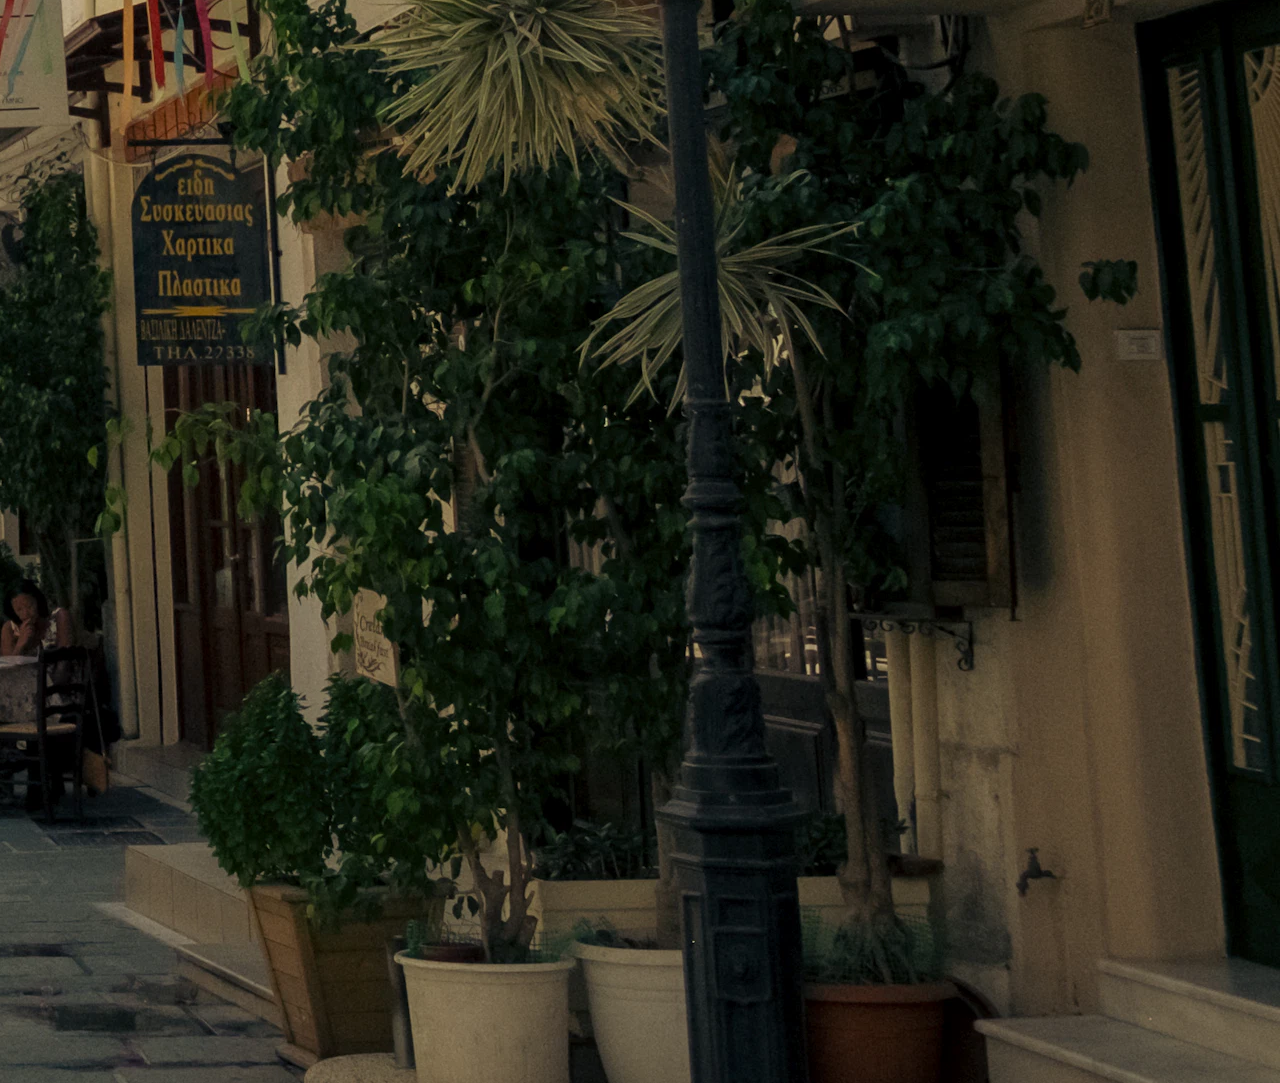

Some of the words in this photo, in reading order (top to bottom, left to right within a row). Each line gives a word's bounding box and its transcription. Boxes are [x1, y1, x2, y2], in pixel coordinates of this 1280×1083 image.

[177, 169, 215, 196] ειδη
[140, 196, 254, 227] Συσκευασιας
[161, 229, 234, 262] Χαρτικα
[158, 270, 242, 297] Πλαστικα
